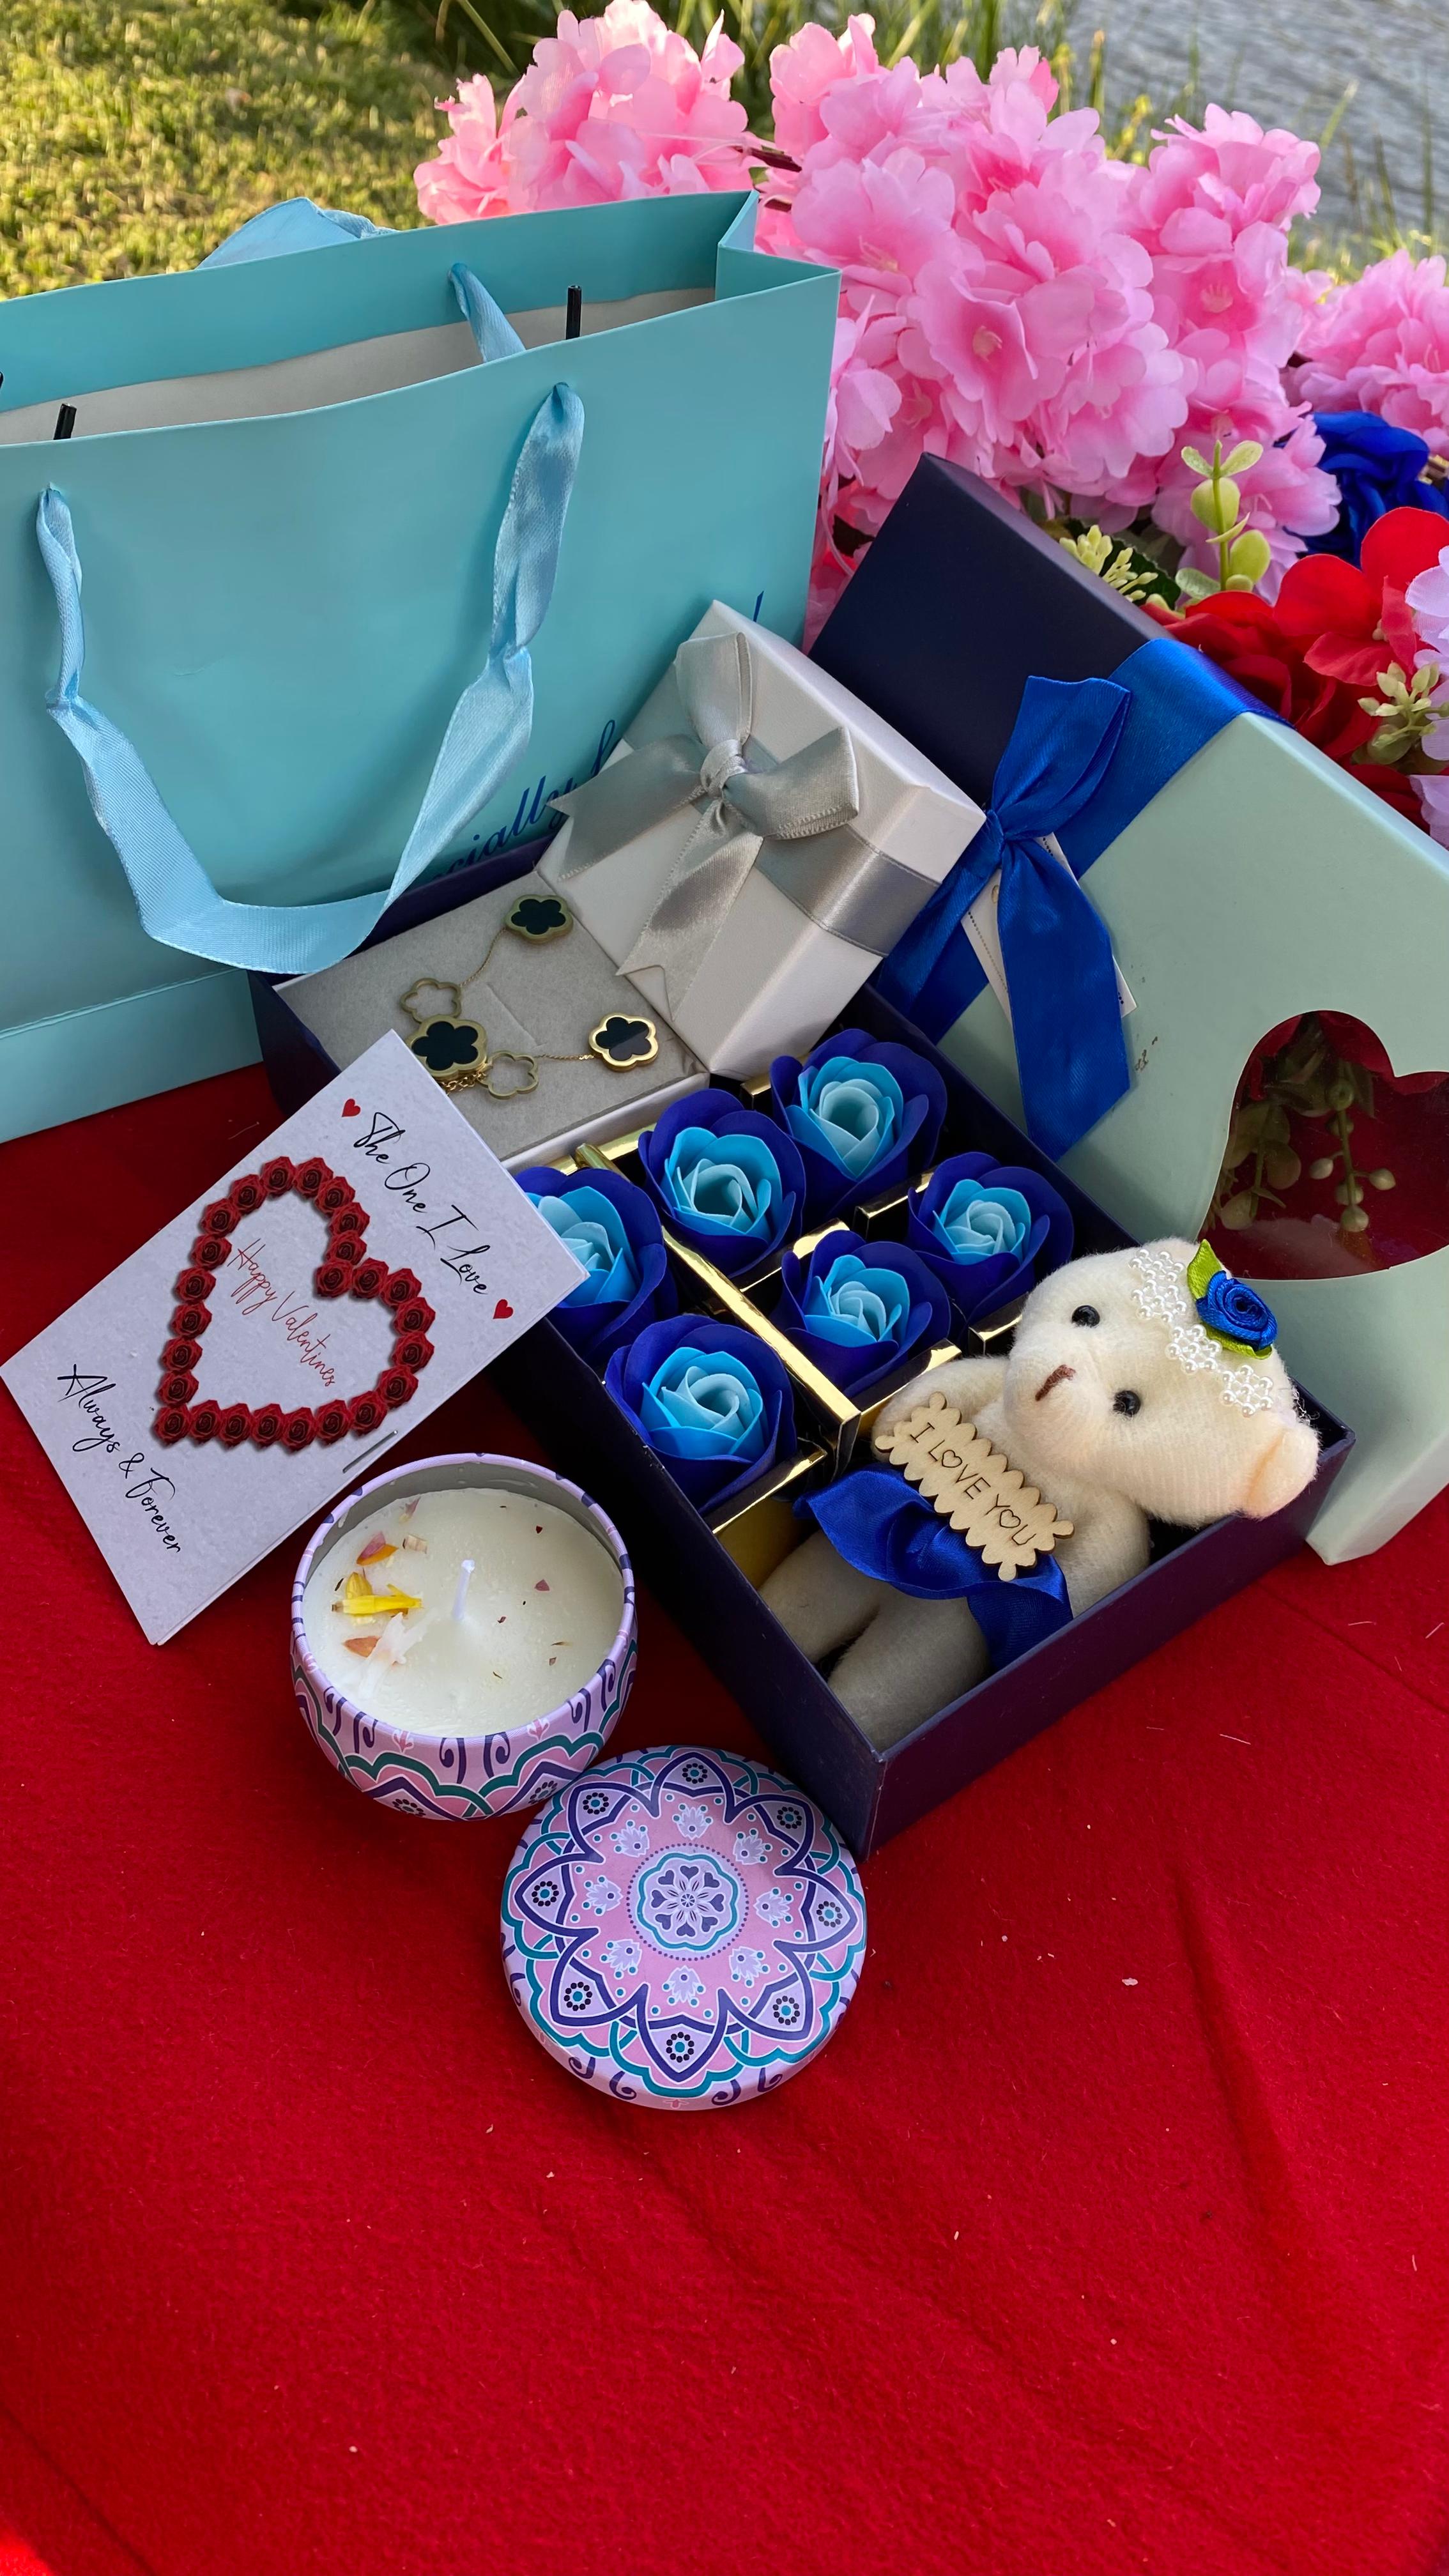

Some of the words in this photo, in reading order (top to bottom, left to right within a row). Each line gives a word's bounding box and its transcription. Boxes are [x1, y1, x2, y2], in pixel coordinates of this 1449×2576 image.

[353, 1112, 406, 1164] The
[384, 1162, 431, 1213] One
[415, 1204, 480, 1251] I
[440, 1244, 491, 1295] Love
[226, 1238, 278, 1316] Happy
[272, 1291, 336, 1387] Valentines
[57, 1363, 121, 1453] Always
[910, 1422, 935, 1443] I
[118, 1452, 145, 1479] &
[125, 1467, 181, 1554] Forever
